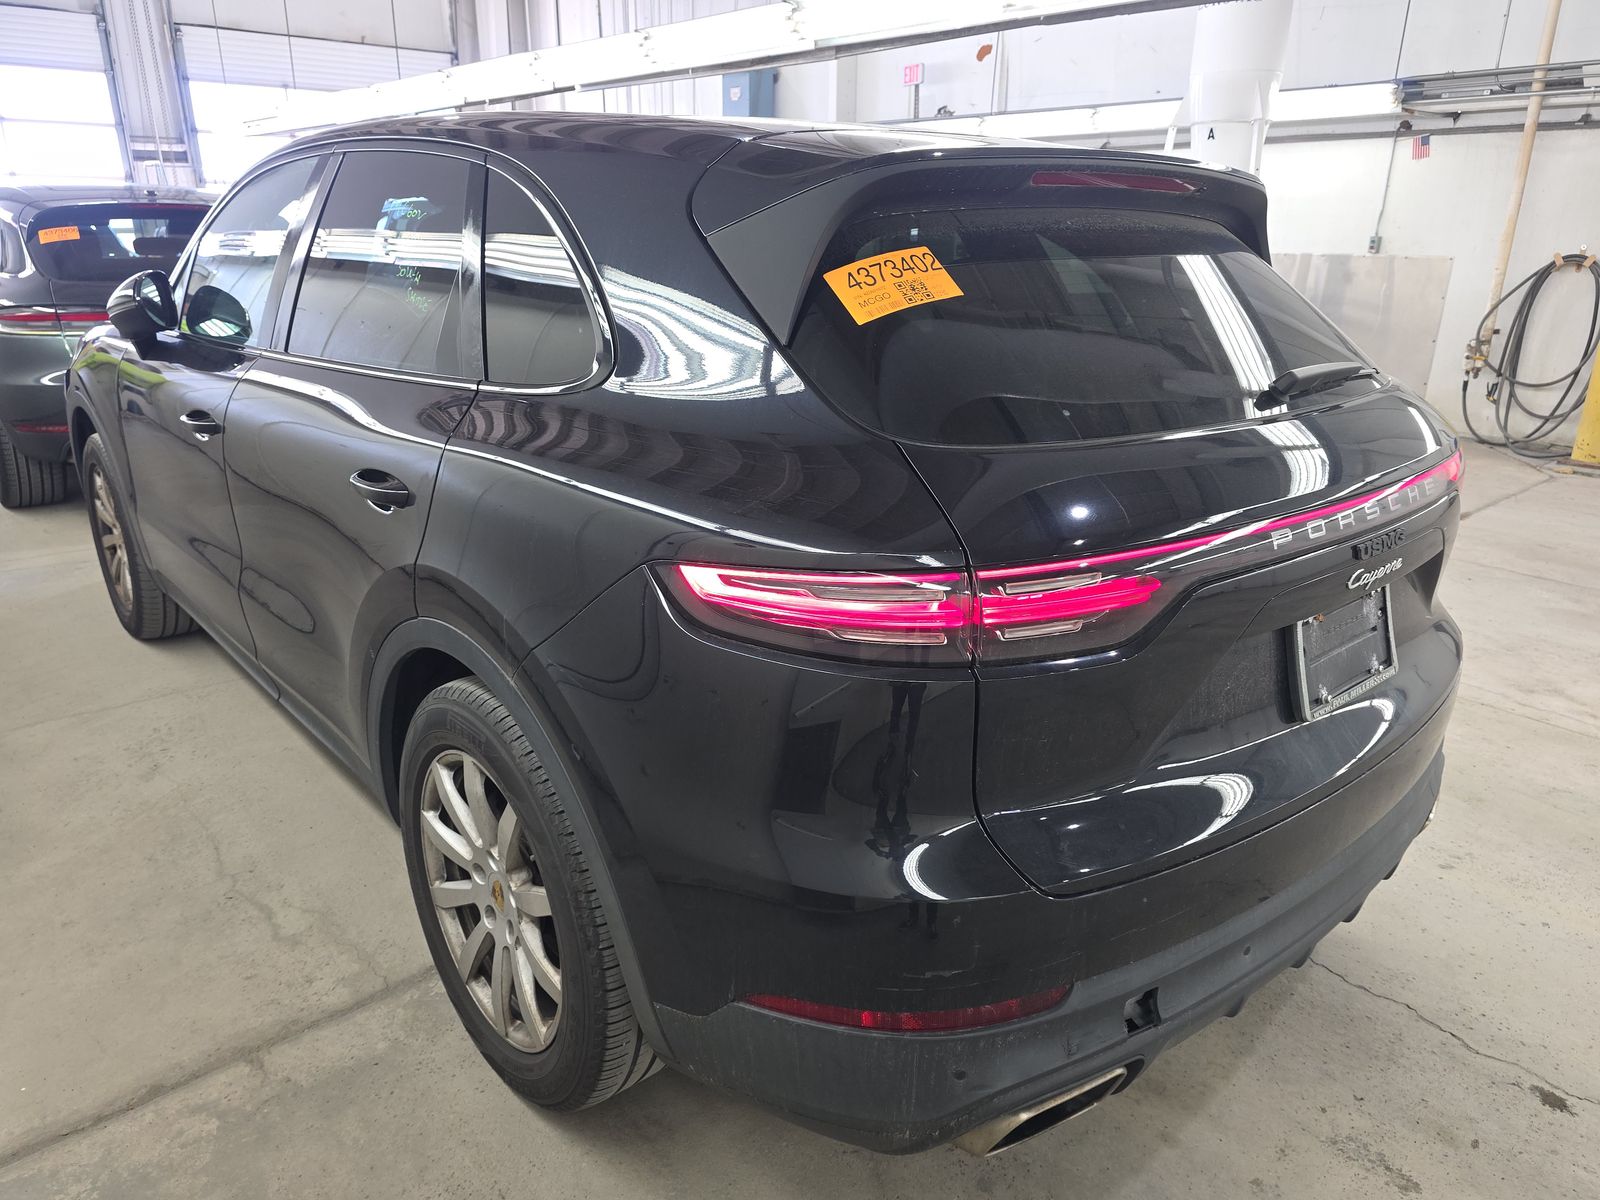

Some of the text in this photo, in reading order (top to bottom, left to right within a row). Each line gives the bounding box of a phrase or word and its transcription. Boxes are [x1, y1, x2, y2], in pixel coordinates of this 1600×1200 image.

[904, 64, 919, 84] EXIT
[1207, 127, 1215, 140] A
[847, 252, 943, 290] 4373402
[1270, 478, 1436, 550] PORSCHE
[1346, 557, 1403, 590] Cayenne
